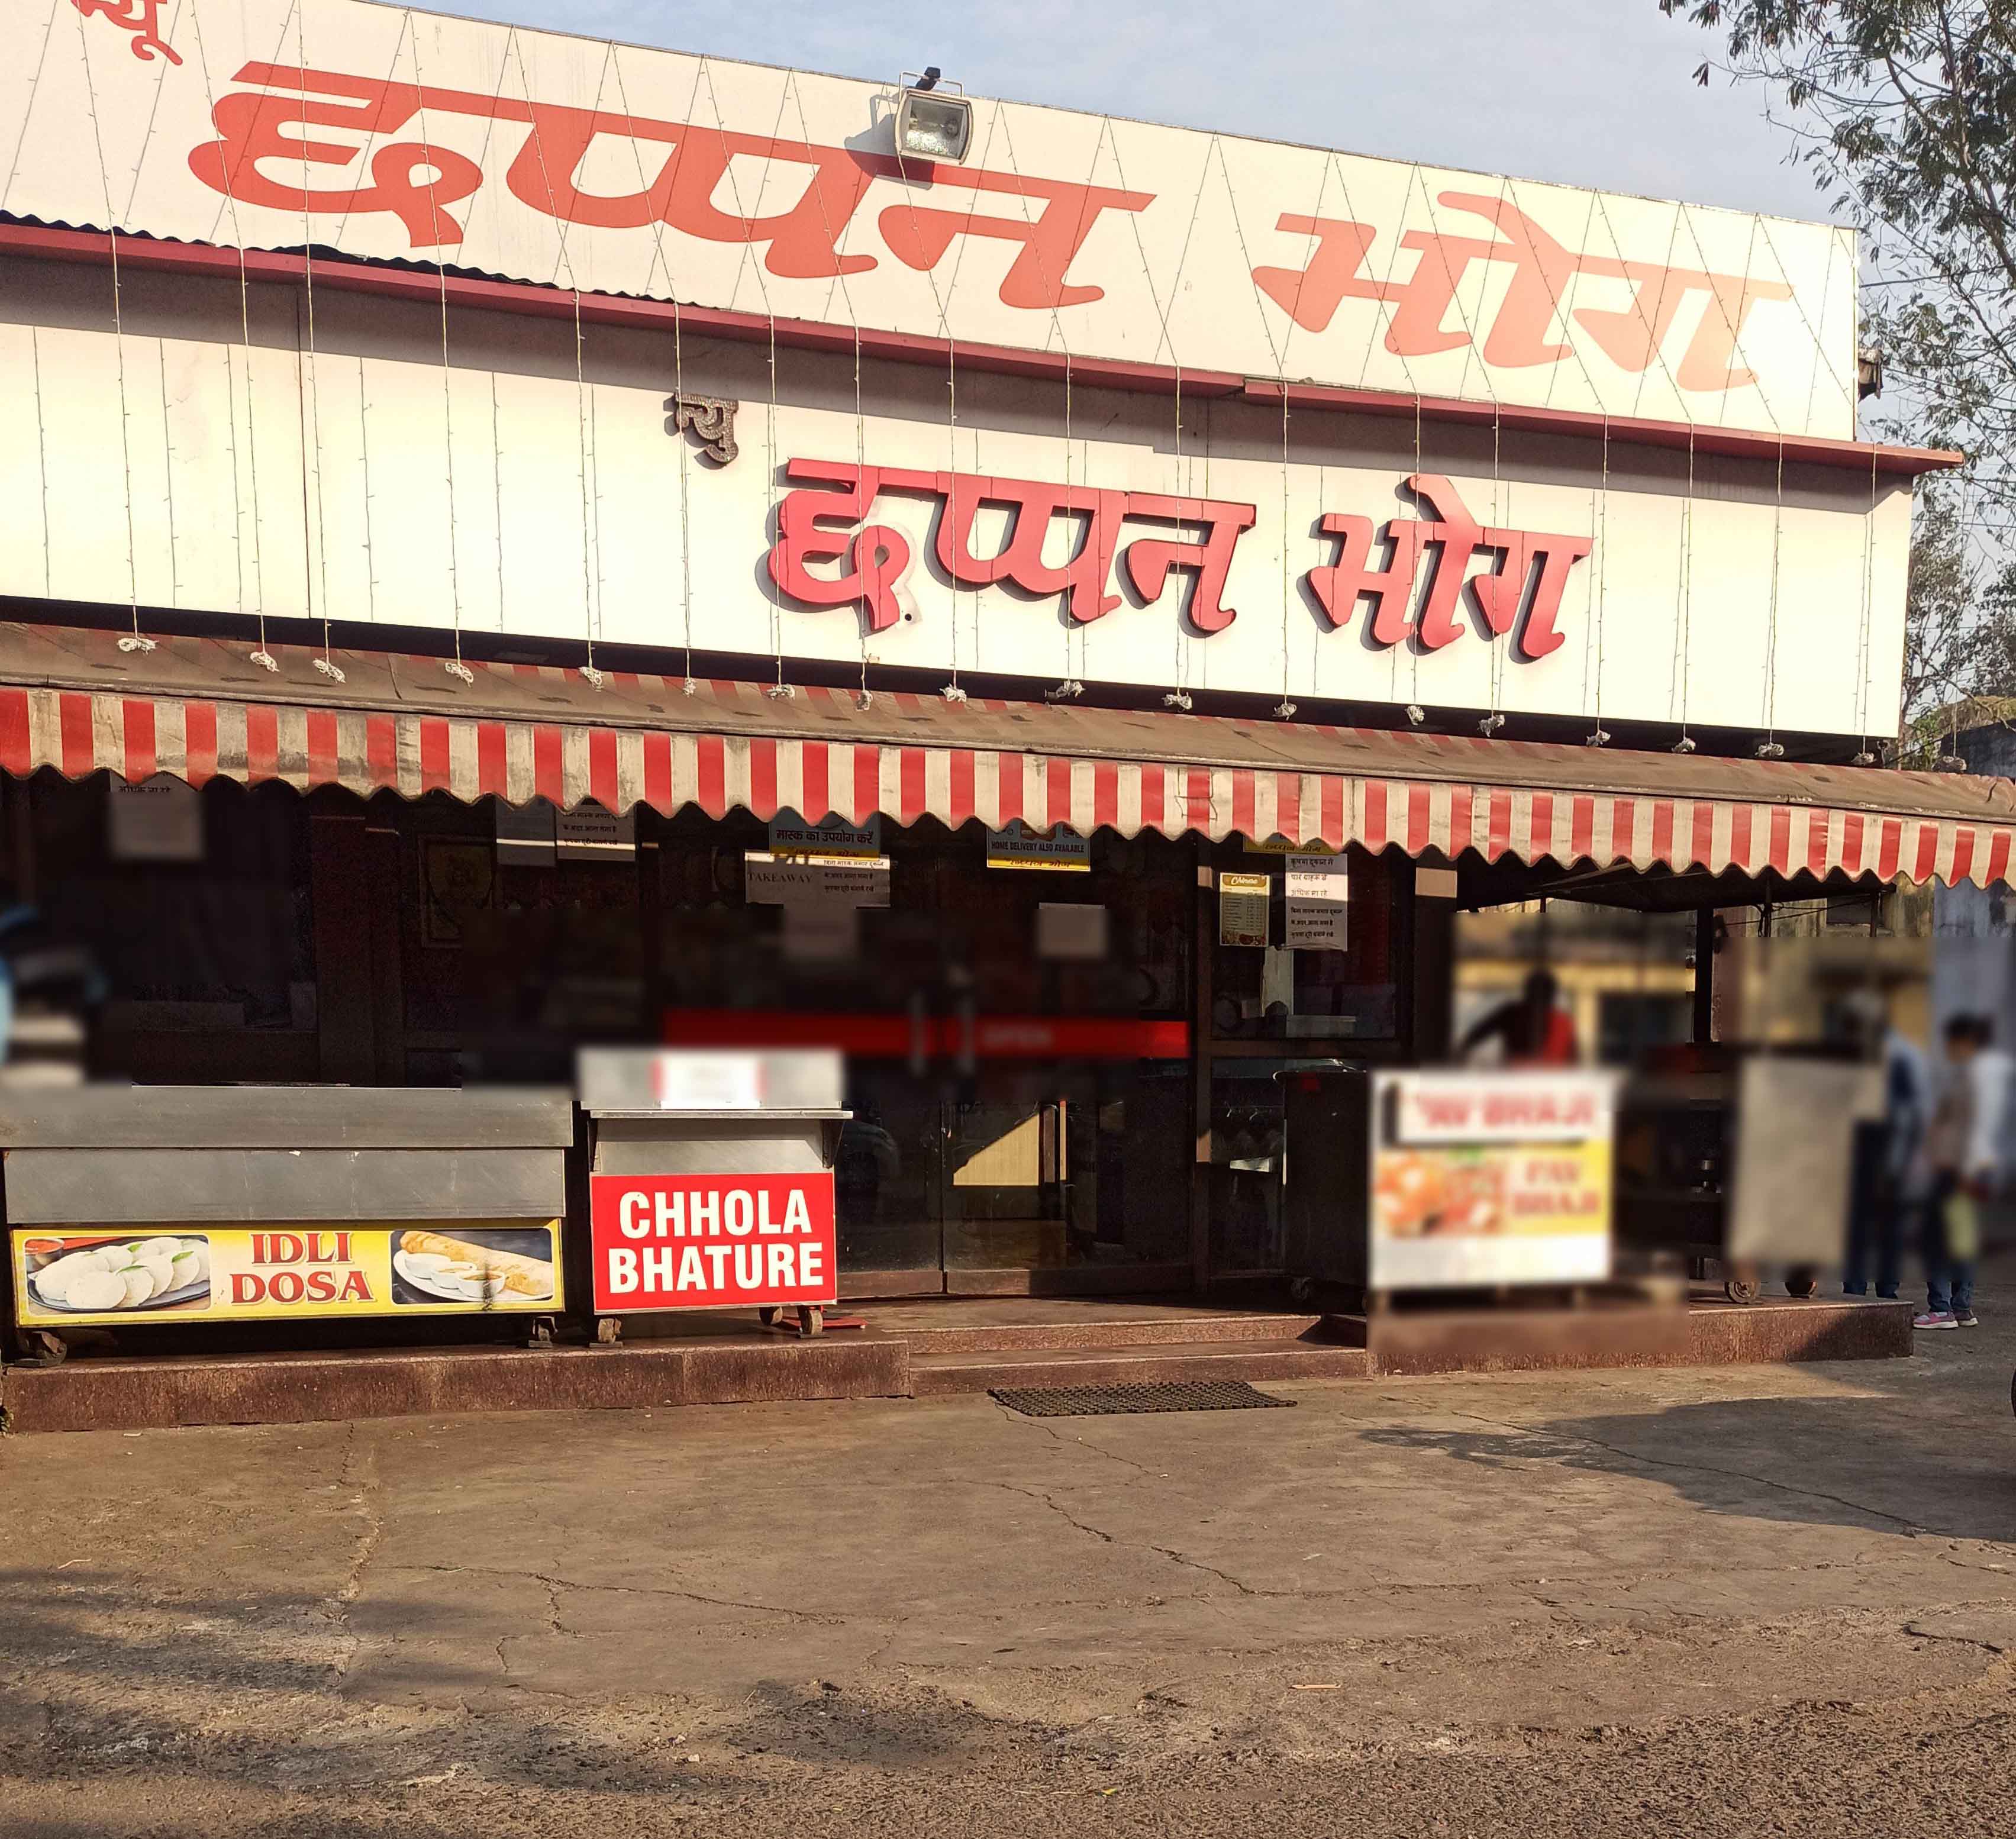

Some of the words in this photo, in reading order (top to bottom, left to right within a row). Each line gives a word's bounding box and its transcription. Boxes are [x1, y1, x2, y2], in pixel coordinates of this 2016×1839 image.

[189, 61, 1157, 309] छप्पन
[1251, 191, 1796, 392] भोग
[766, 457, 1256, 634] छप्पन
[1307, 473, 1592, 658] भोग
[805, 831, 819, 841] का
[821, 829, 854, 843] उपयोग
[991, 841, 1009, 850] HOME
[1010, 841, 1037, 851] DELIVERY
[1038, 843, 1053, 852] ALSO
[1054, 843, 1085, 853] AVAILABLE
[619, 1189, 812, 1239] CHHOLA
[250, 1232, 354, 1264] IDLI
[608, 1242, 824, 1294] BHATURE
[230, 1270, 375, 1305] DOSA
